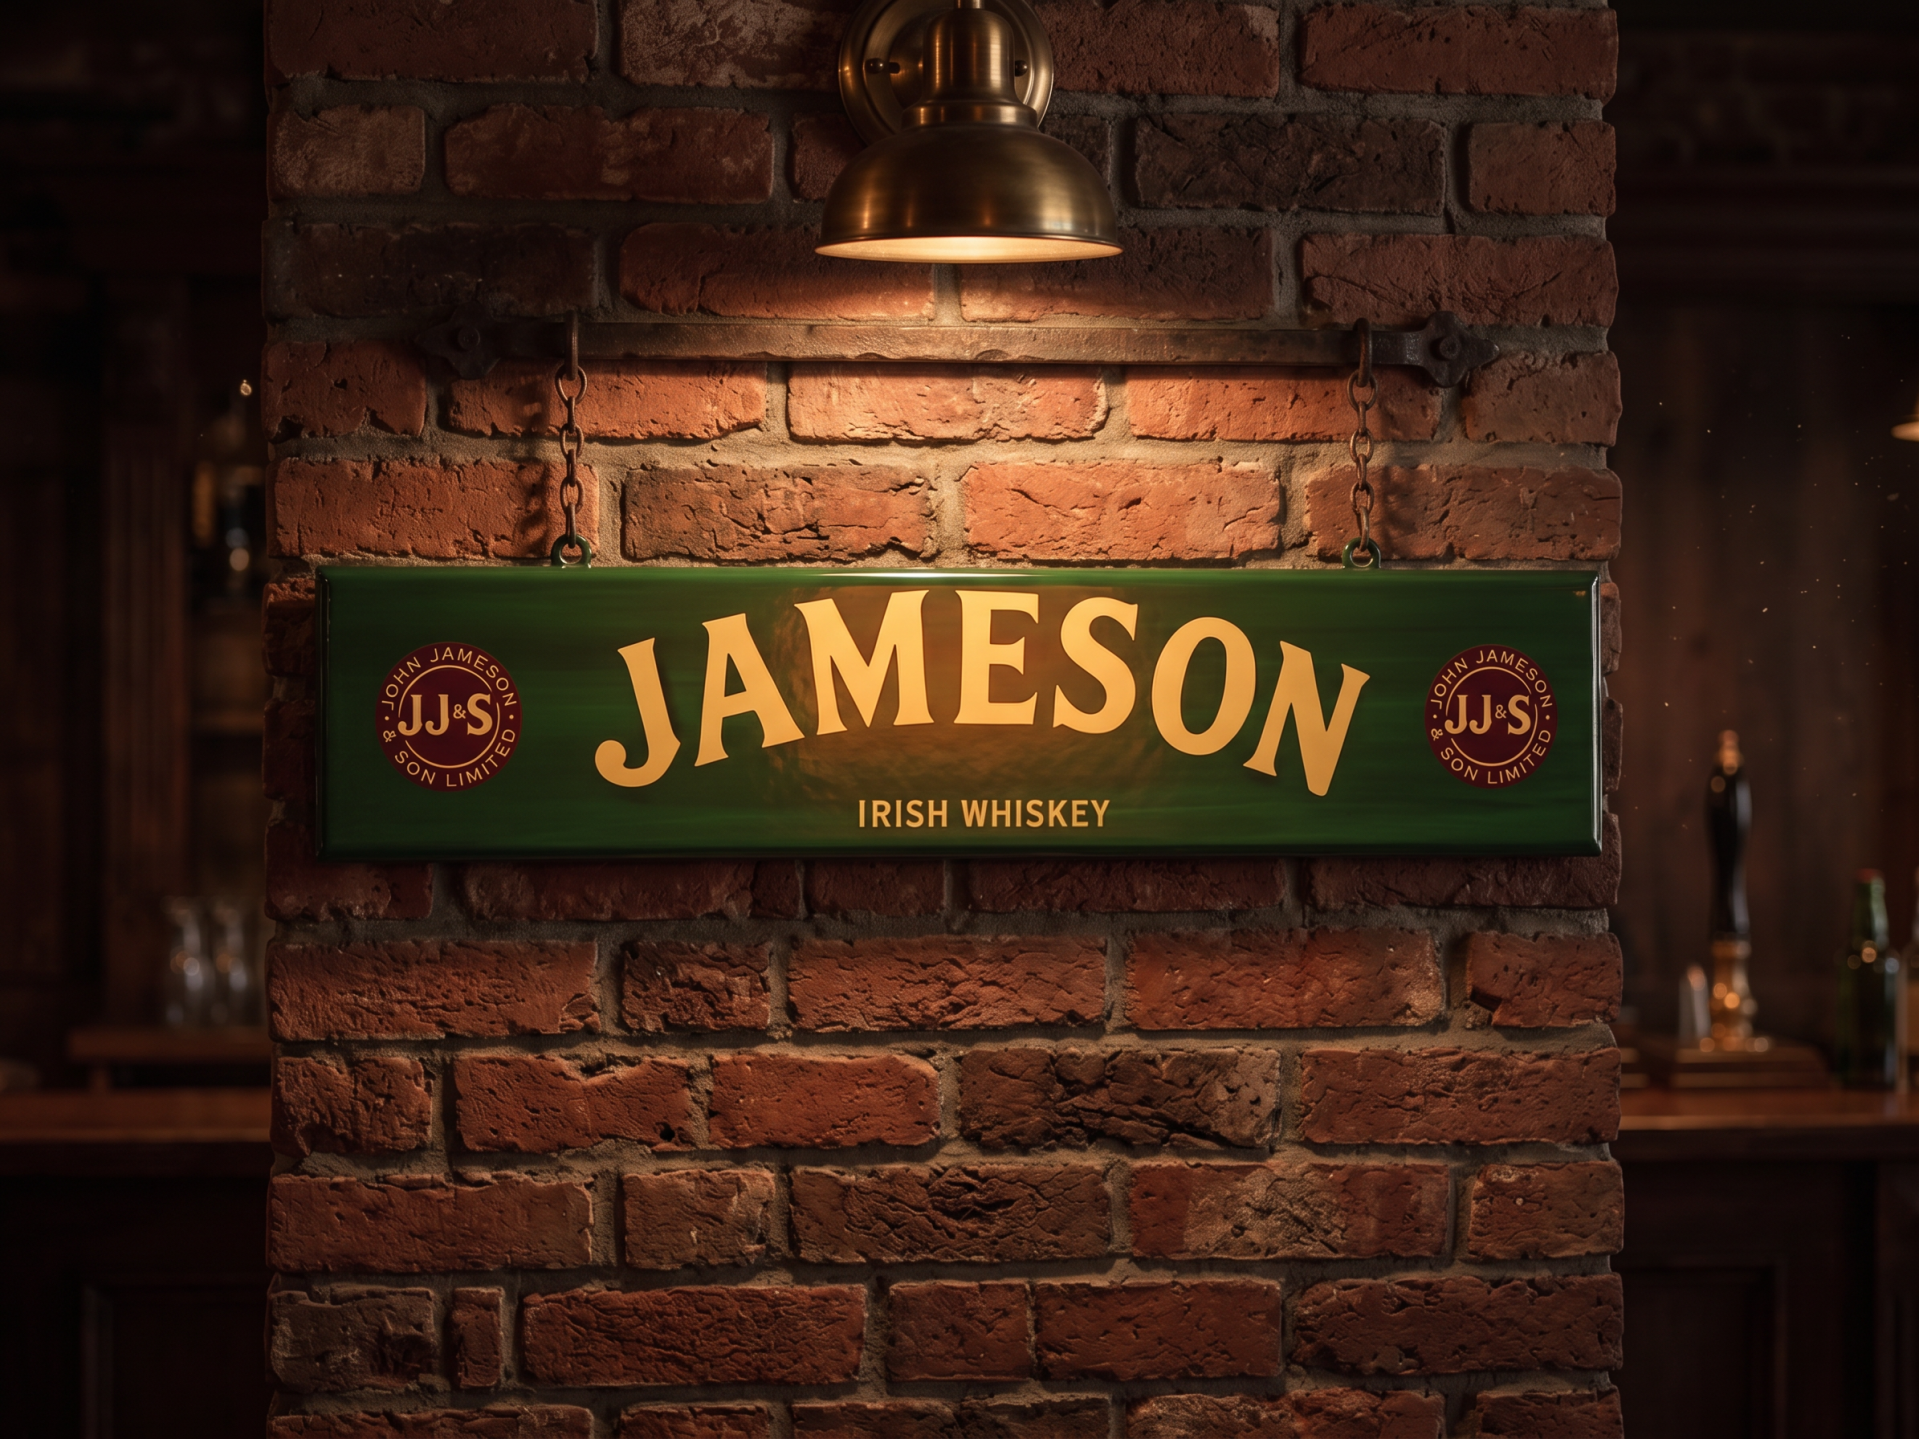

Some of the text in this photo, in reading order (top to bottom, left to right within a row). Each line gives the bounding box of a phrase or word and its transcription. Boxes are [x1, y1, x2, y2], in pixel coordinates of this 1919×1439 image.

[381, 646, 518, 711] JOHN JAMESON
[594, 588, 1371, 797] JAMESON
[1430, 649, 1553, 710] JOHN JAMESON
[397, 692, 493, 736] JJ&S
[1444, 694, 1532, 735] JJ&S
[382, 729, 516, 787] & SON LIMITED
[1430, 728, 1551, 784] & SON LIMITED
[858, 799, 1111, 828] IRISH WHISKEY
